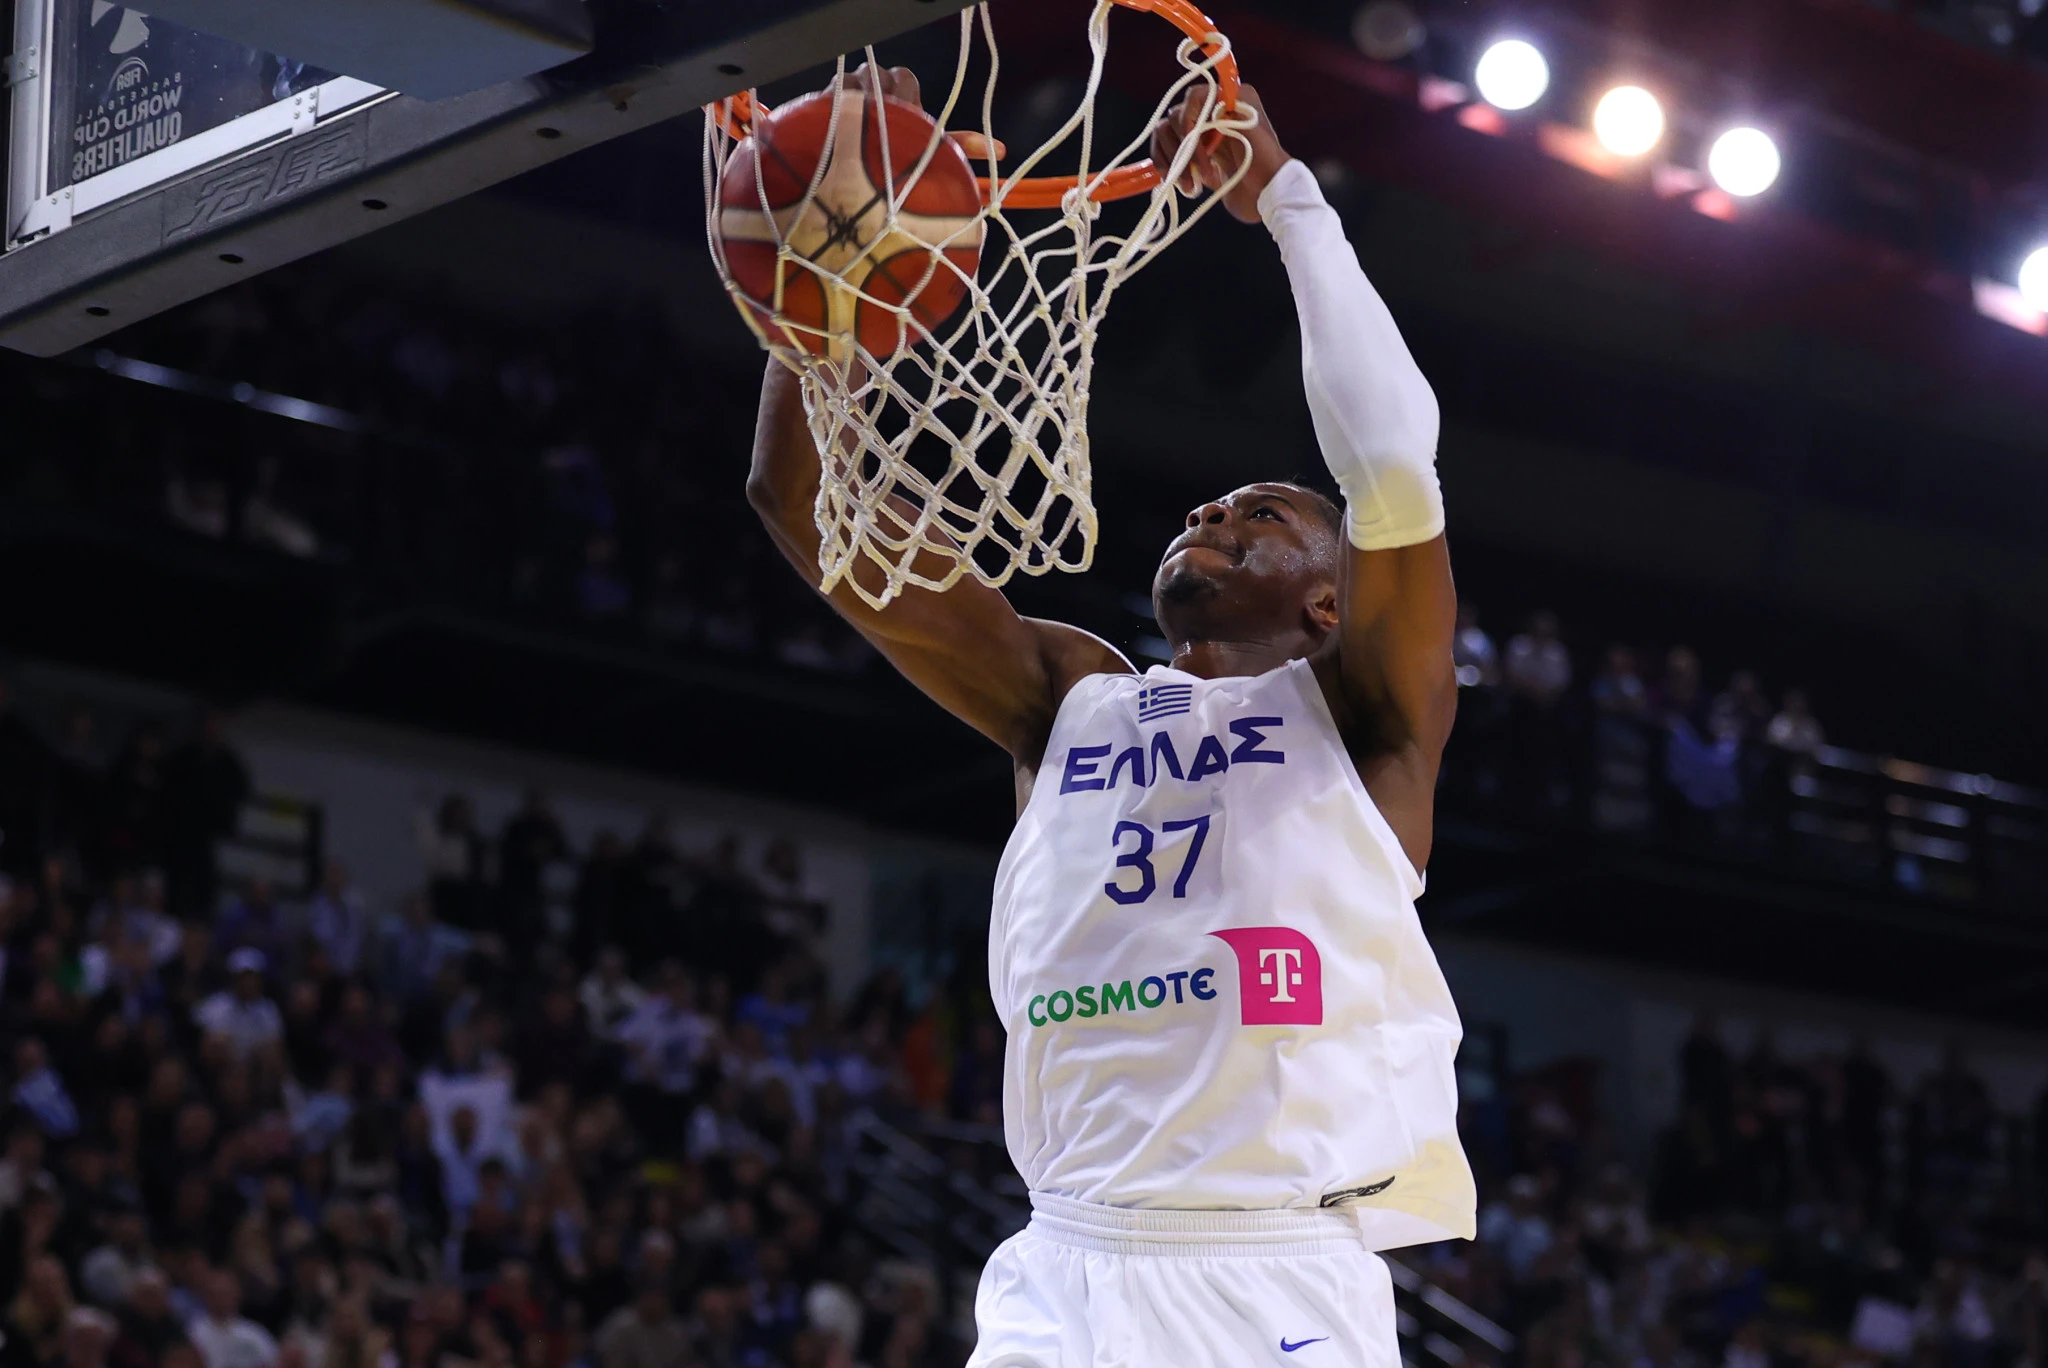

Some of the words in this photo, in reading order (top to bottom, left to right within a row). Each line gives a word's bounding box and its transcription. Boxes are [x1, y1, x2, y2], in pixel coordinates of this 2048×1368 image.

[1059, 716, 1285, 796] ΕΛΛΑΣ
[1104, 814, 1211, 905] 37
[1027, 967, 1218, 1027] COSMOTE
[1258, 948, 1302, 1003] T
